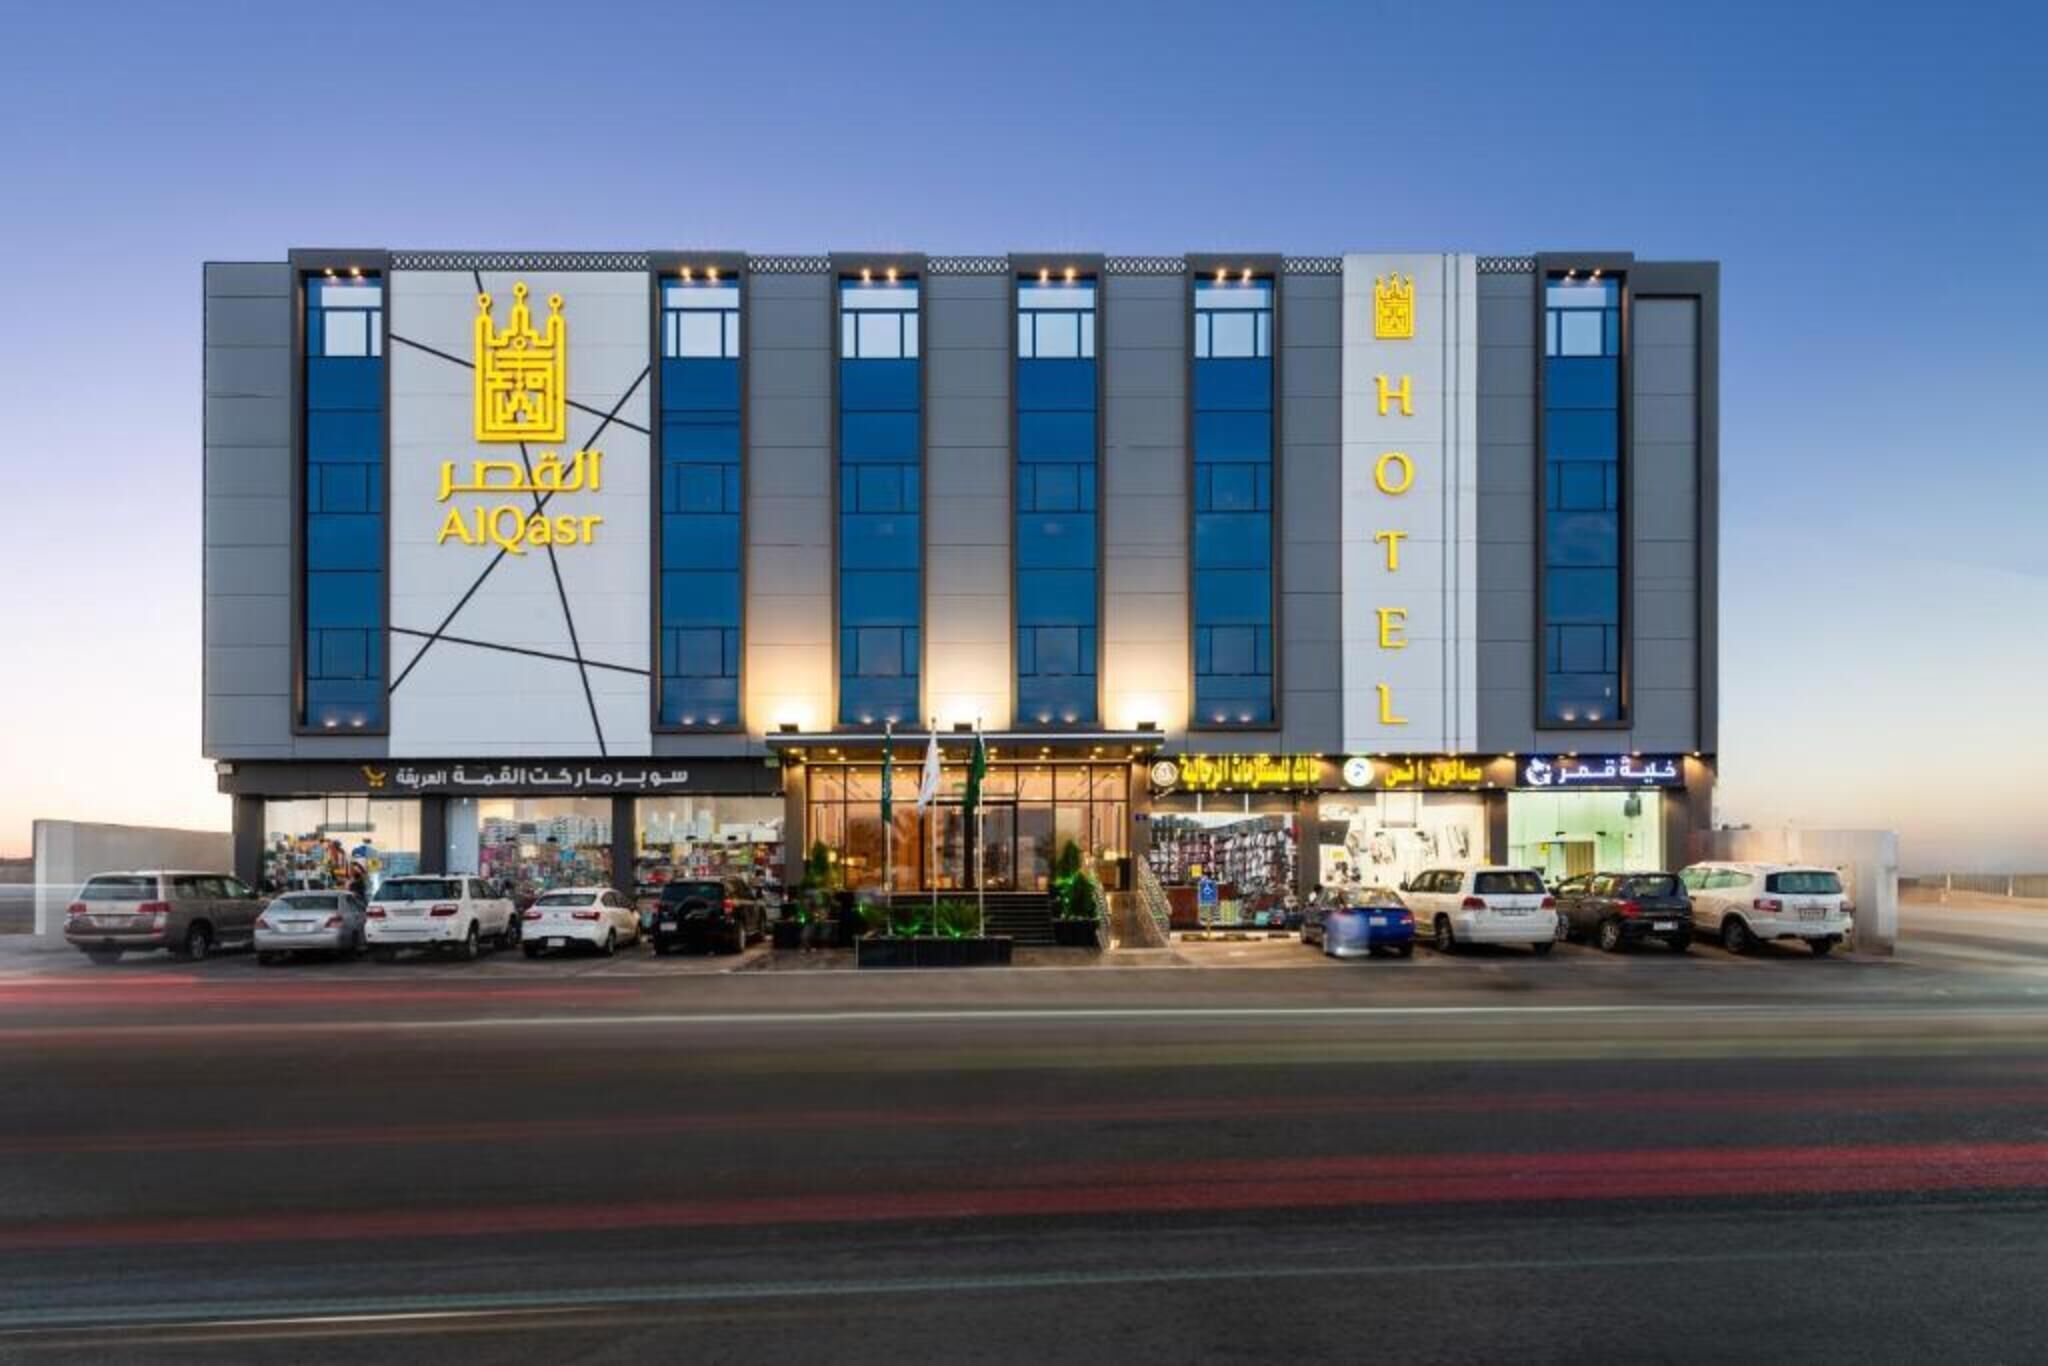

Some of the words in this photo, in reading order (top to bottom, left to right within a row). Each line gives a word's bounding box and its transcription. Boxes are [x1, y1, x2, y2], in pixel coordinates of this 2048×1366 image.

[437, 450, 603, 502] القصر
[437, 505, 603, 556] AlQasr
[1374, 373, 1414, 726] HOTEL
[396, 768, 447, 788] العريقة
[453, 765, 526, 785] القمة
[1428, 757, 1482, 786] صالون
[1558, 759, 1616, 783] قمر
[1619, 755, 1677, 783] خلية
